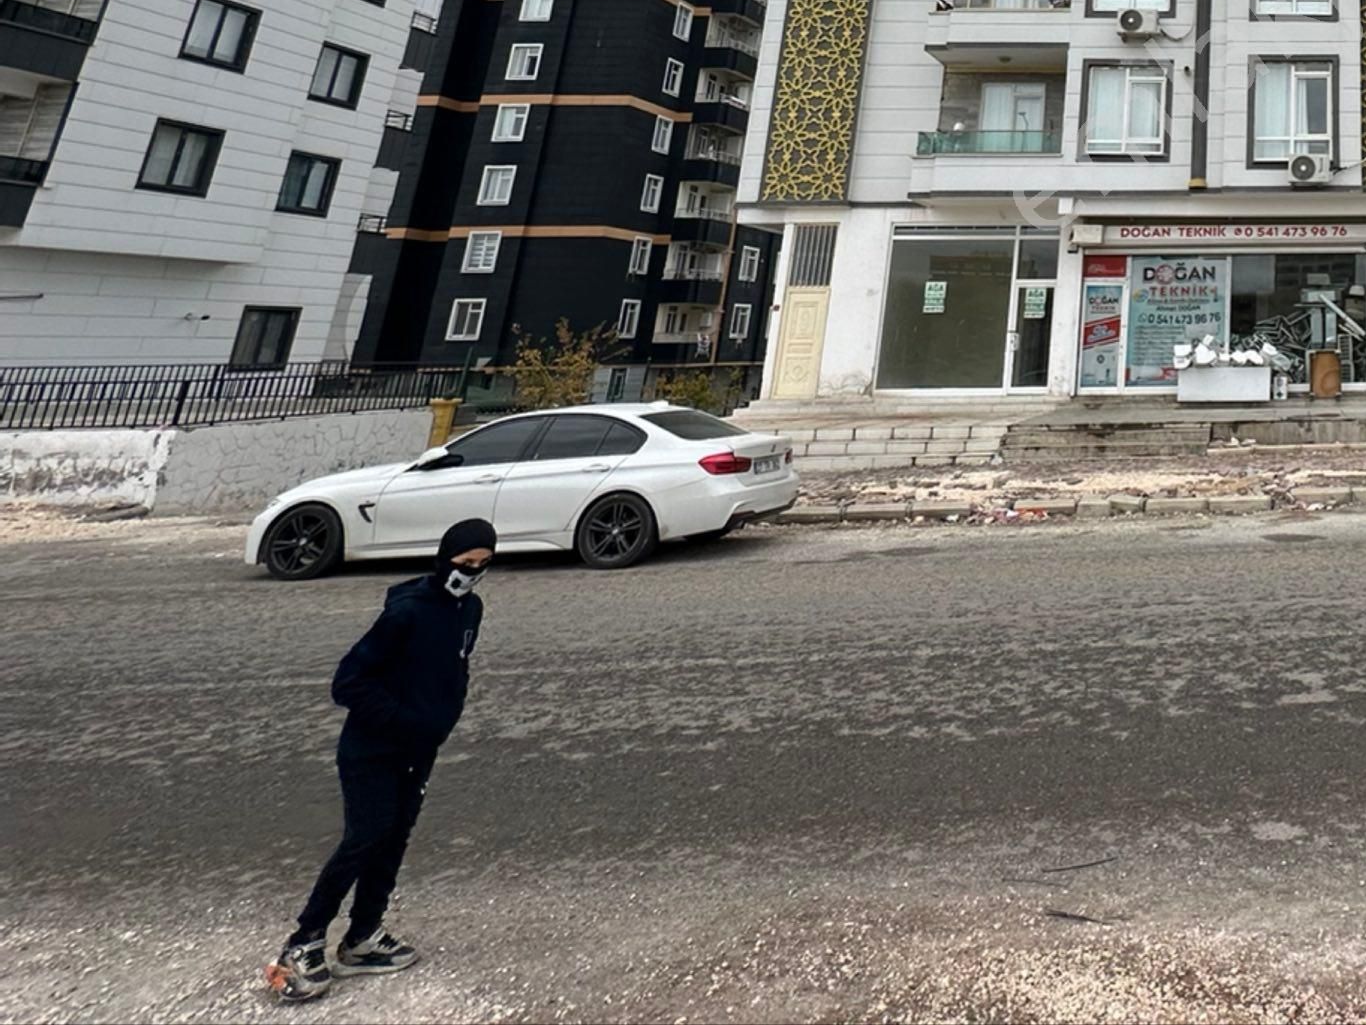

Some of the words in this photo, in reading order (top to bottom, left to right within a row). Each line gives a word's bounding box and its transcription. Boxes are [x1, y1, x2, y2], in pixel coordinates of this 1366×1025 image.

[1244, 226, 1254, 238] 0
[1257, 226, 1279, 238] 541
[1282, 226, 1308, 238] 473
[1310, 225, 1328, 237] 96
[1331, 225, 1348, 237] 76
[1142, 262, 1216, 285] DOĞAN
[1149, 284, 1208, 297] TEKNİK
[1147, 313, 1156, 324] 0
[1156, 314, 1173, 325] 541
[1174, 314, 1192, 325] 473
[1194, 314, 1208, 325] 96
[1209, 312, 1222, 323] 76
